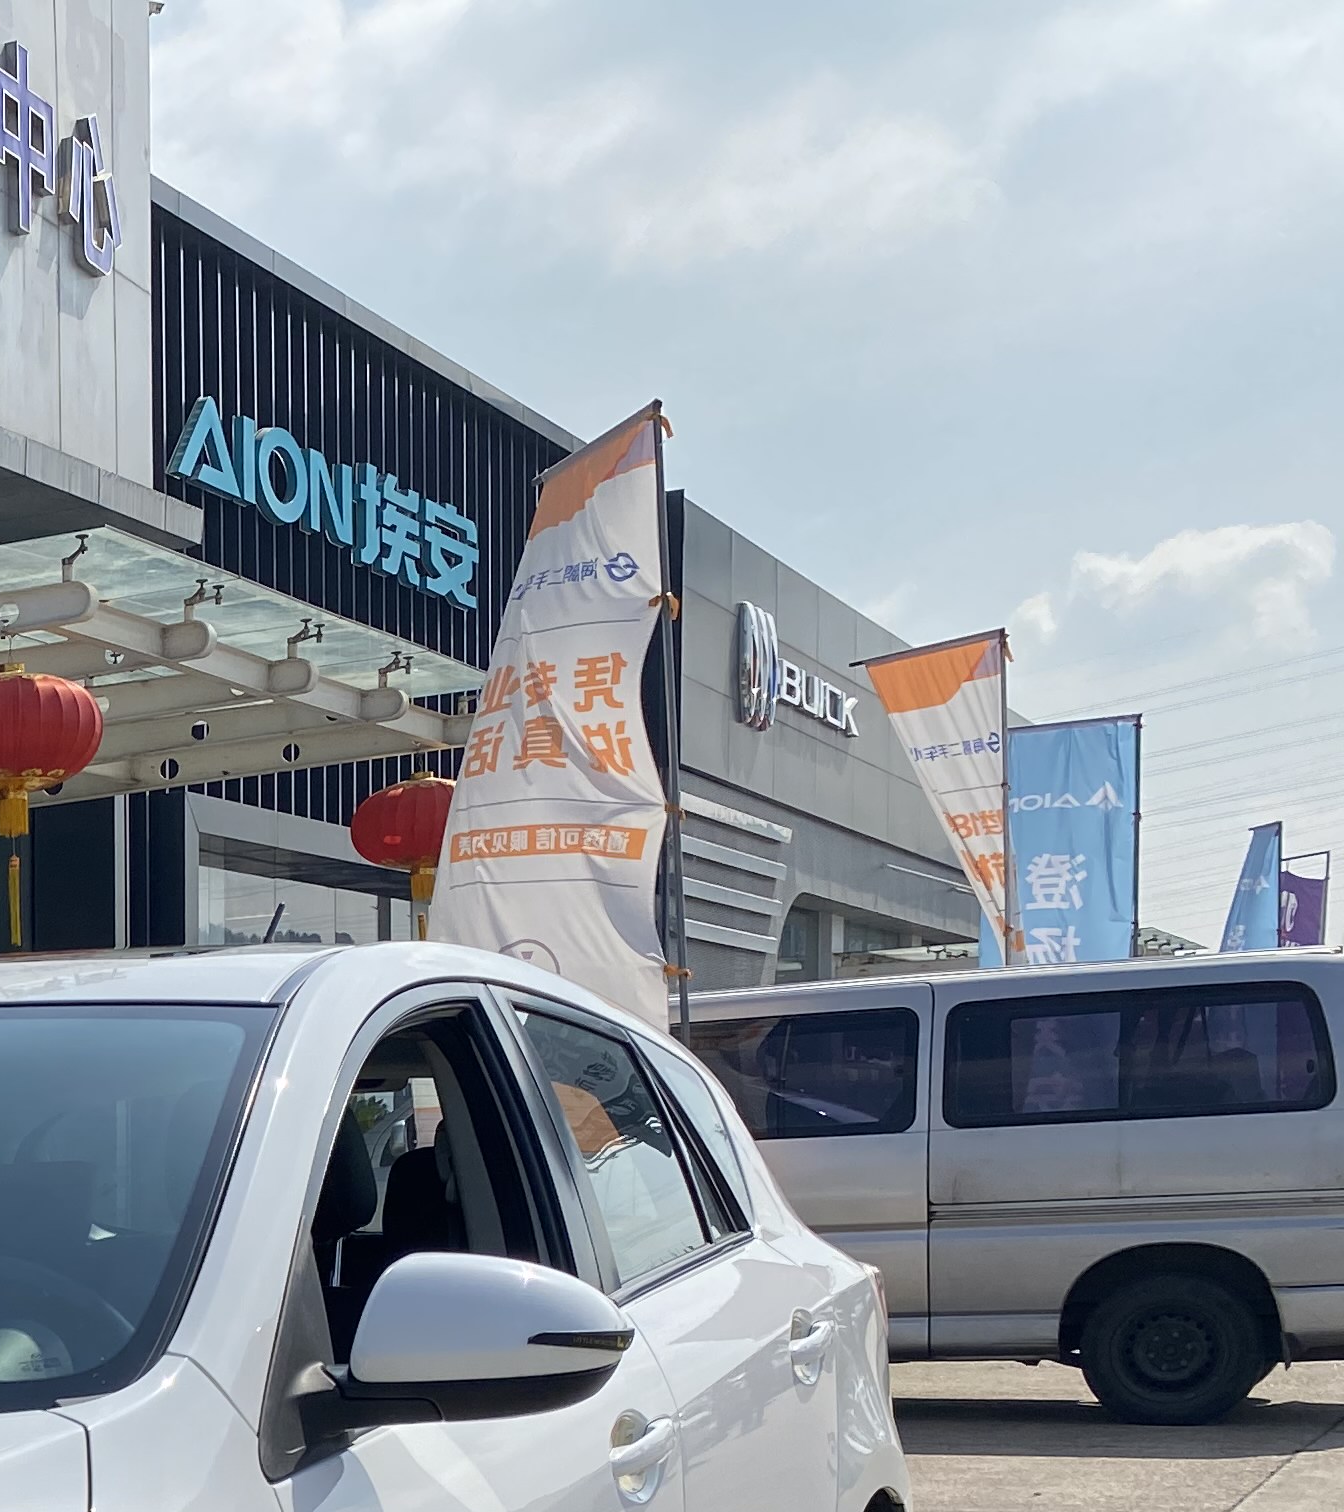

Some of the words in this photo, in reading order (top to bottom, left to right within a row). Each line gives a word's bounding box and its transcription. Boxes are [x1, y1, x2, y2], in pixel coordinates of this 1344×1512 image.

[169, 395, 353, 547] AION
[354, 462, 479, 610] 埃安
[777, 657, 860, 738] BUICK
